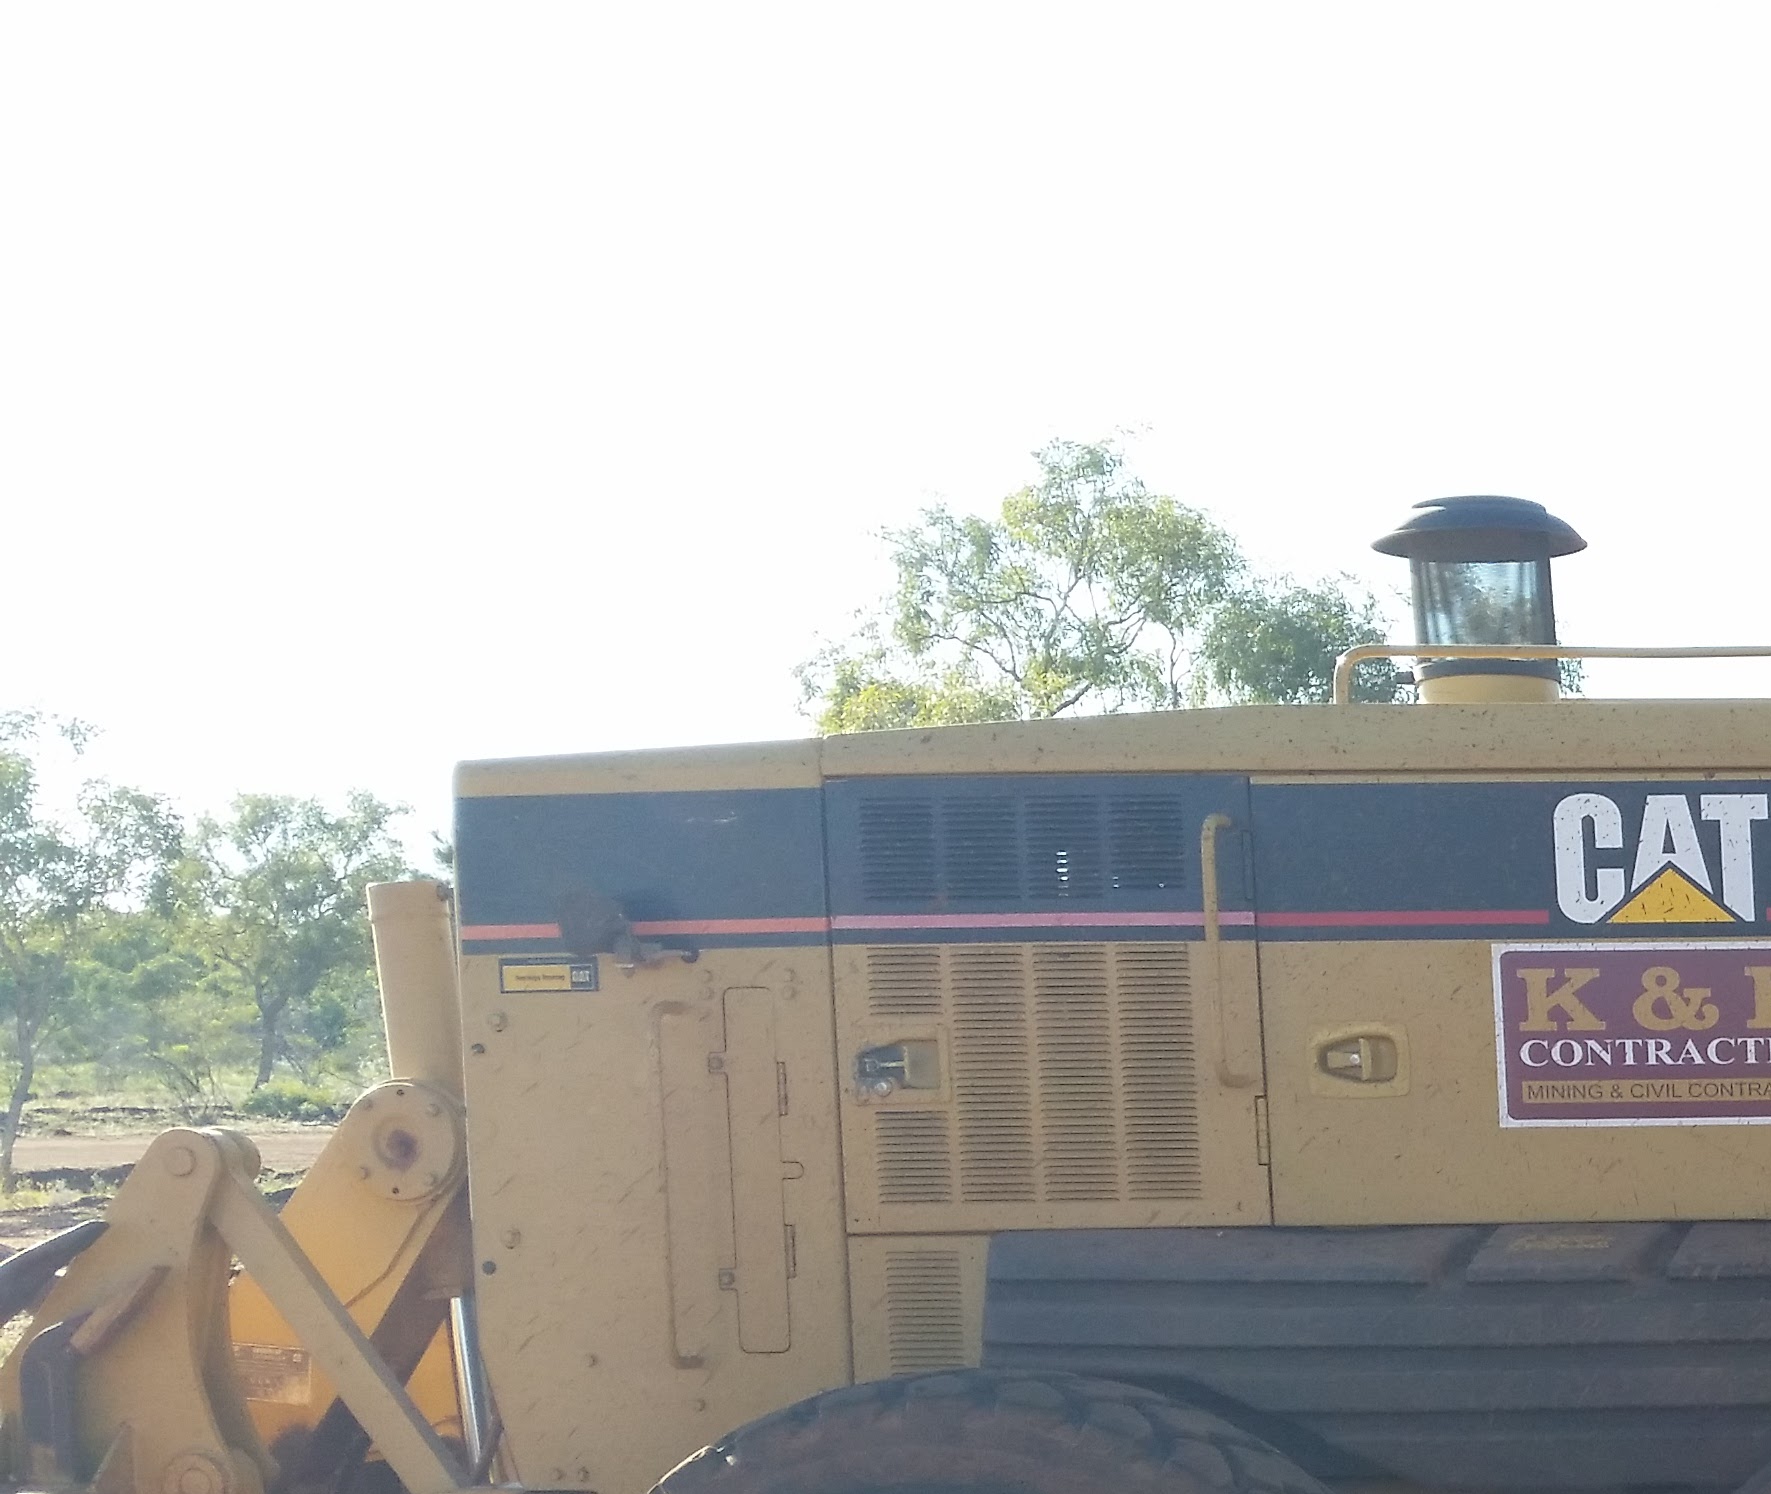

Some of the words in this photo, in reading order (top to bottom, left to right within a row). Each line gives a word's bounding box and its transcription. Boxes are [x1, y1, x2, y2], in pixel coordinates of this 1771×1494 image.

[1552, 792, 1769, 925] CAT
[1516, 967, 1606, 1032] K
[1632, 965, 1720, 1032] &
[1527, 1082, 1603, 1101] MINING
[1610, 1083, 1624, 1099] &
[1630, 1082, 1683, 1099] CIVIL
